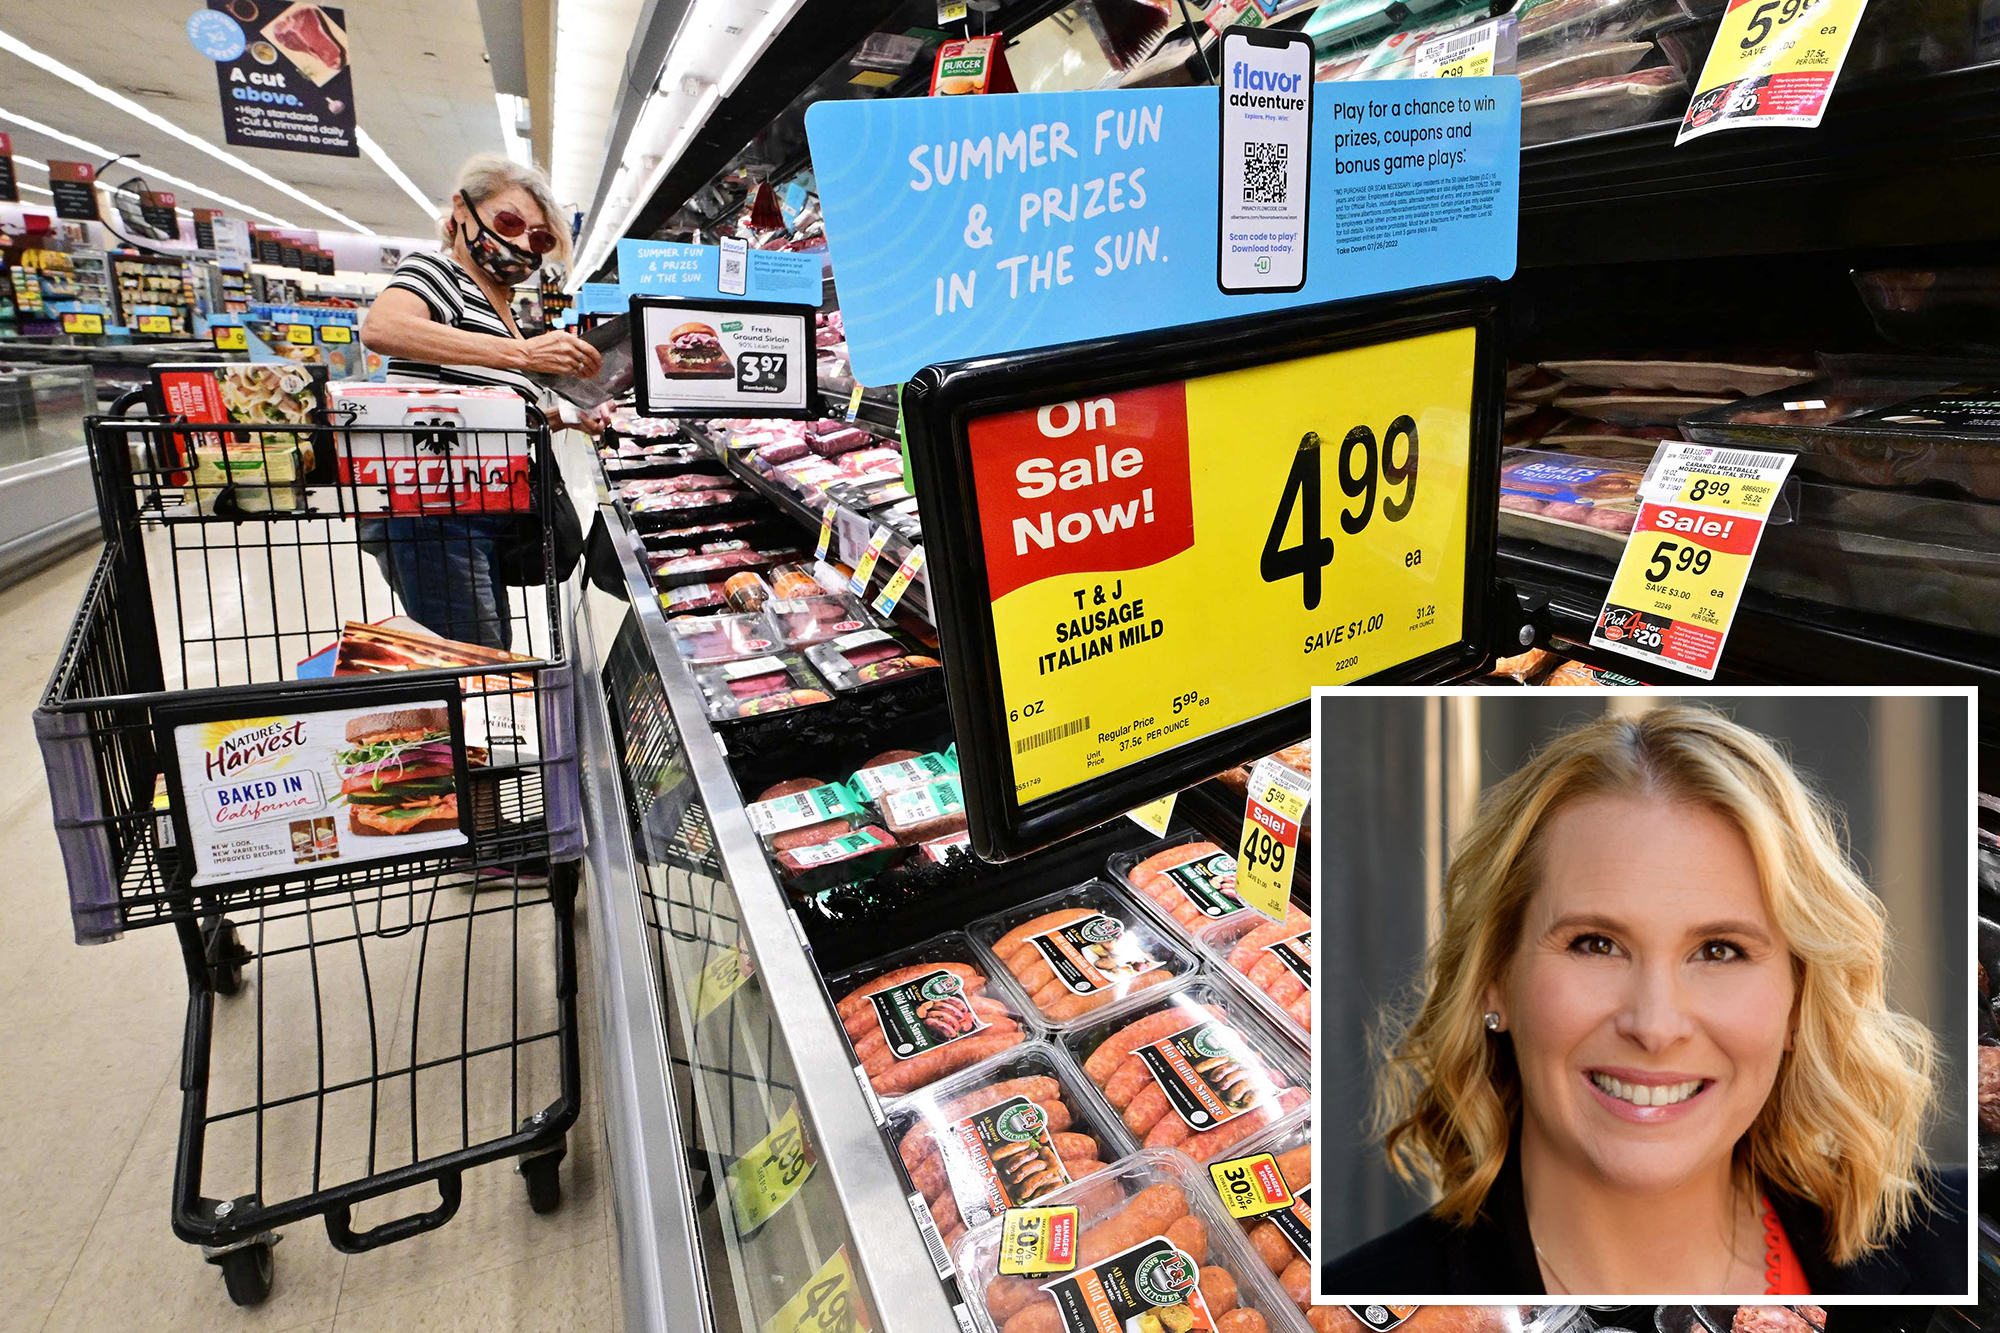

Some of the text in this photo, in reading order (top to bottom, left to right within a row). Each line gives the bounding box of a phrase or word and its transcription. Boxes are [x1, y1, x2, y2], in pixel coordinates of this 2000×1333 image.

[1820, 26, 1837, 35] ea
[1740, 46, 1766, 59] SAVE
[944, 60, 981, 70] BURGER
[230, 67, 286, 88] A cut
[1233, 61, 1301, 93] flavor
[232, 86, 304, 107] above.
[240, 106, 319, 123] High standards
[1334, 95, 1495, 124] Play for a chance to win
[241, 117, 345, 138] Cut & trimmed daily
[243, 127, 349, 147] Custom cuts to order
[1335, 122, 1472, 153] prizes, coupons and
[909, 104, 1163, 191] SUMMER FUN
[78, 166, 88, 177] 9
[1335, 158, 1380, 175] bonus
[1384, 154, 1425, 175] game
[160, 194, 175, 204] 10
[964, 167, 1147, 249] & PRIZES
[1229, 233, 1248, 241] Scan
[1250, 233, 1268, 241] code
[1269, 233, 1277, 241] to
[638, 248, 703, 258] SUMMER FUN
[1231, 244, 1294, 254] Download today.
[1351, 245, 1366, 253] Down
[649, 260, 698, 271] & PRIZES
[935, 226, 1168, 316] IN THE SUN.
[640, 274, 652, 284] IN
[656, 273, 677, 283] THE
[733, 333, 790, 343] Ground Sirloin
[751, 325, 772, 333] Fresh
[1037, 397, 1116, 438] On
[362, 459, 509, 495] TECATE
[1015, 445, 1144, 499] Sale
[1514, 469, 1583, 483] ORIGINAL
[1678, 466, 1721, 477] MOZZARELLA
[1685, 462, 1759, 474] CARANDO MEATBALLS
[1012, 488, 1155, 556] Now!
[1655, 510, 1734, 539] Sale!
[1405, 549, 1422, 568] ea
[1074, 579, 1122, 611] T & J
[1645, 583, 1724, 600] SAVE $3.00 ea
[1416, 604, 1436, 620] 31.2¢
[1654, 601, 1716, 618] 22249 37.5¢
[1055, 599, 1145, 644] SAUSAGE
[1603, 611, 1627, 627] Pick
[1624, 612, 1642, 639] 4
[1645, 621, 1660, 632] for
[1304, 613, 1384, 655] SAVE $1.00
[1038, 618, 1164, 676] ITALIAN MILD
[1335, 656, 1359, 672] 22200
[1023, 700, 1045, 718] OZ
[1199, 696, 1210, 707] ea
[224, 722, 283, 754] NATURE'S
[1098, 715, 1155, 744] Regular Price
[1119, 718, 1190, 752] 37.5¢ PER OUNCE
[205, 720, 307, 782] Harvest
[1086, 750, 1101, 761] Unit
[1087, 757, 1105, 768] Price
[218, 776, 302, 806] BAKED IN
[216, 795, 319, 823] California
[1253, 806, 1286, 835] Sale!
[214, 849, 286, 864] IMPROVED RECIPES!
[1162, 1043, 1224, 1117] Hot Italian Sausage
[1224, 1167, 1256, 1205] 30%
[1258, 1170, 1273, 1194] SPECIAL
[1235, 1195, 1248, 1210] OFF
[1017, 1217, 1040, 1260] 30%
[1053, 1224, 1062, 1252] SPECIAL
[1015, 1248, 1024, 1265] OFF
[1138, 1256, 1159, 1288] SAUSAGE
[1084, 1277, 1101, 1303] Mild
[1111, 1265, 1137, 1308] All Natural
[1142, 1286, 1182, 1303] KITCHEN
